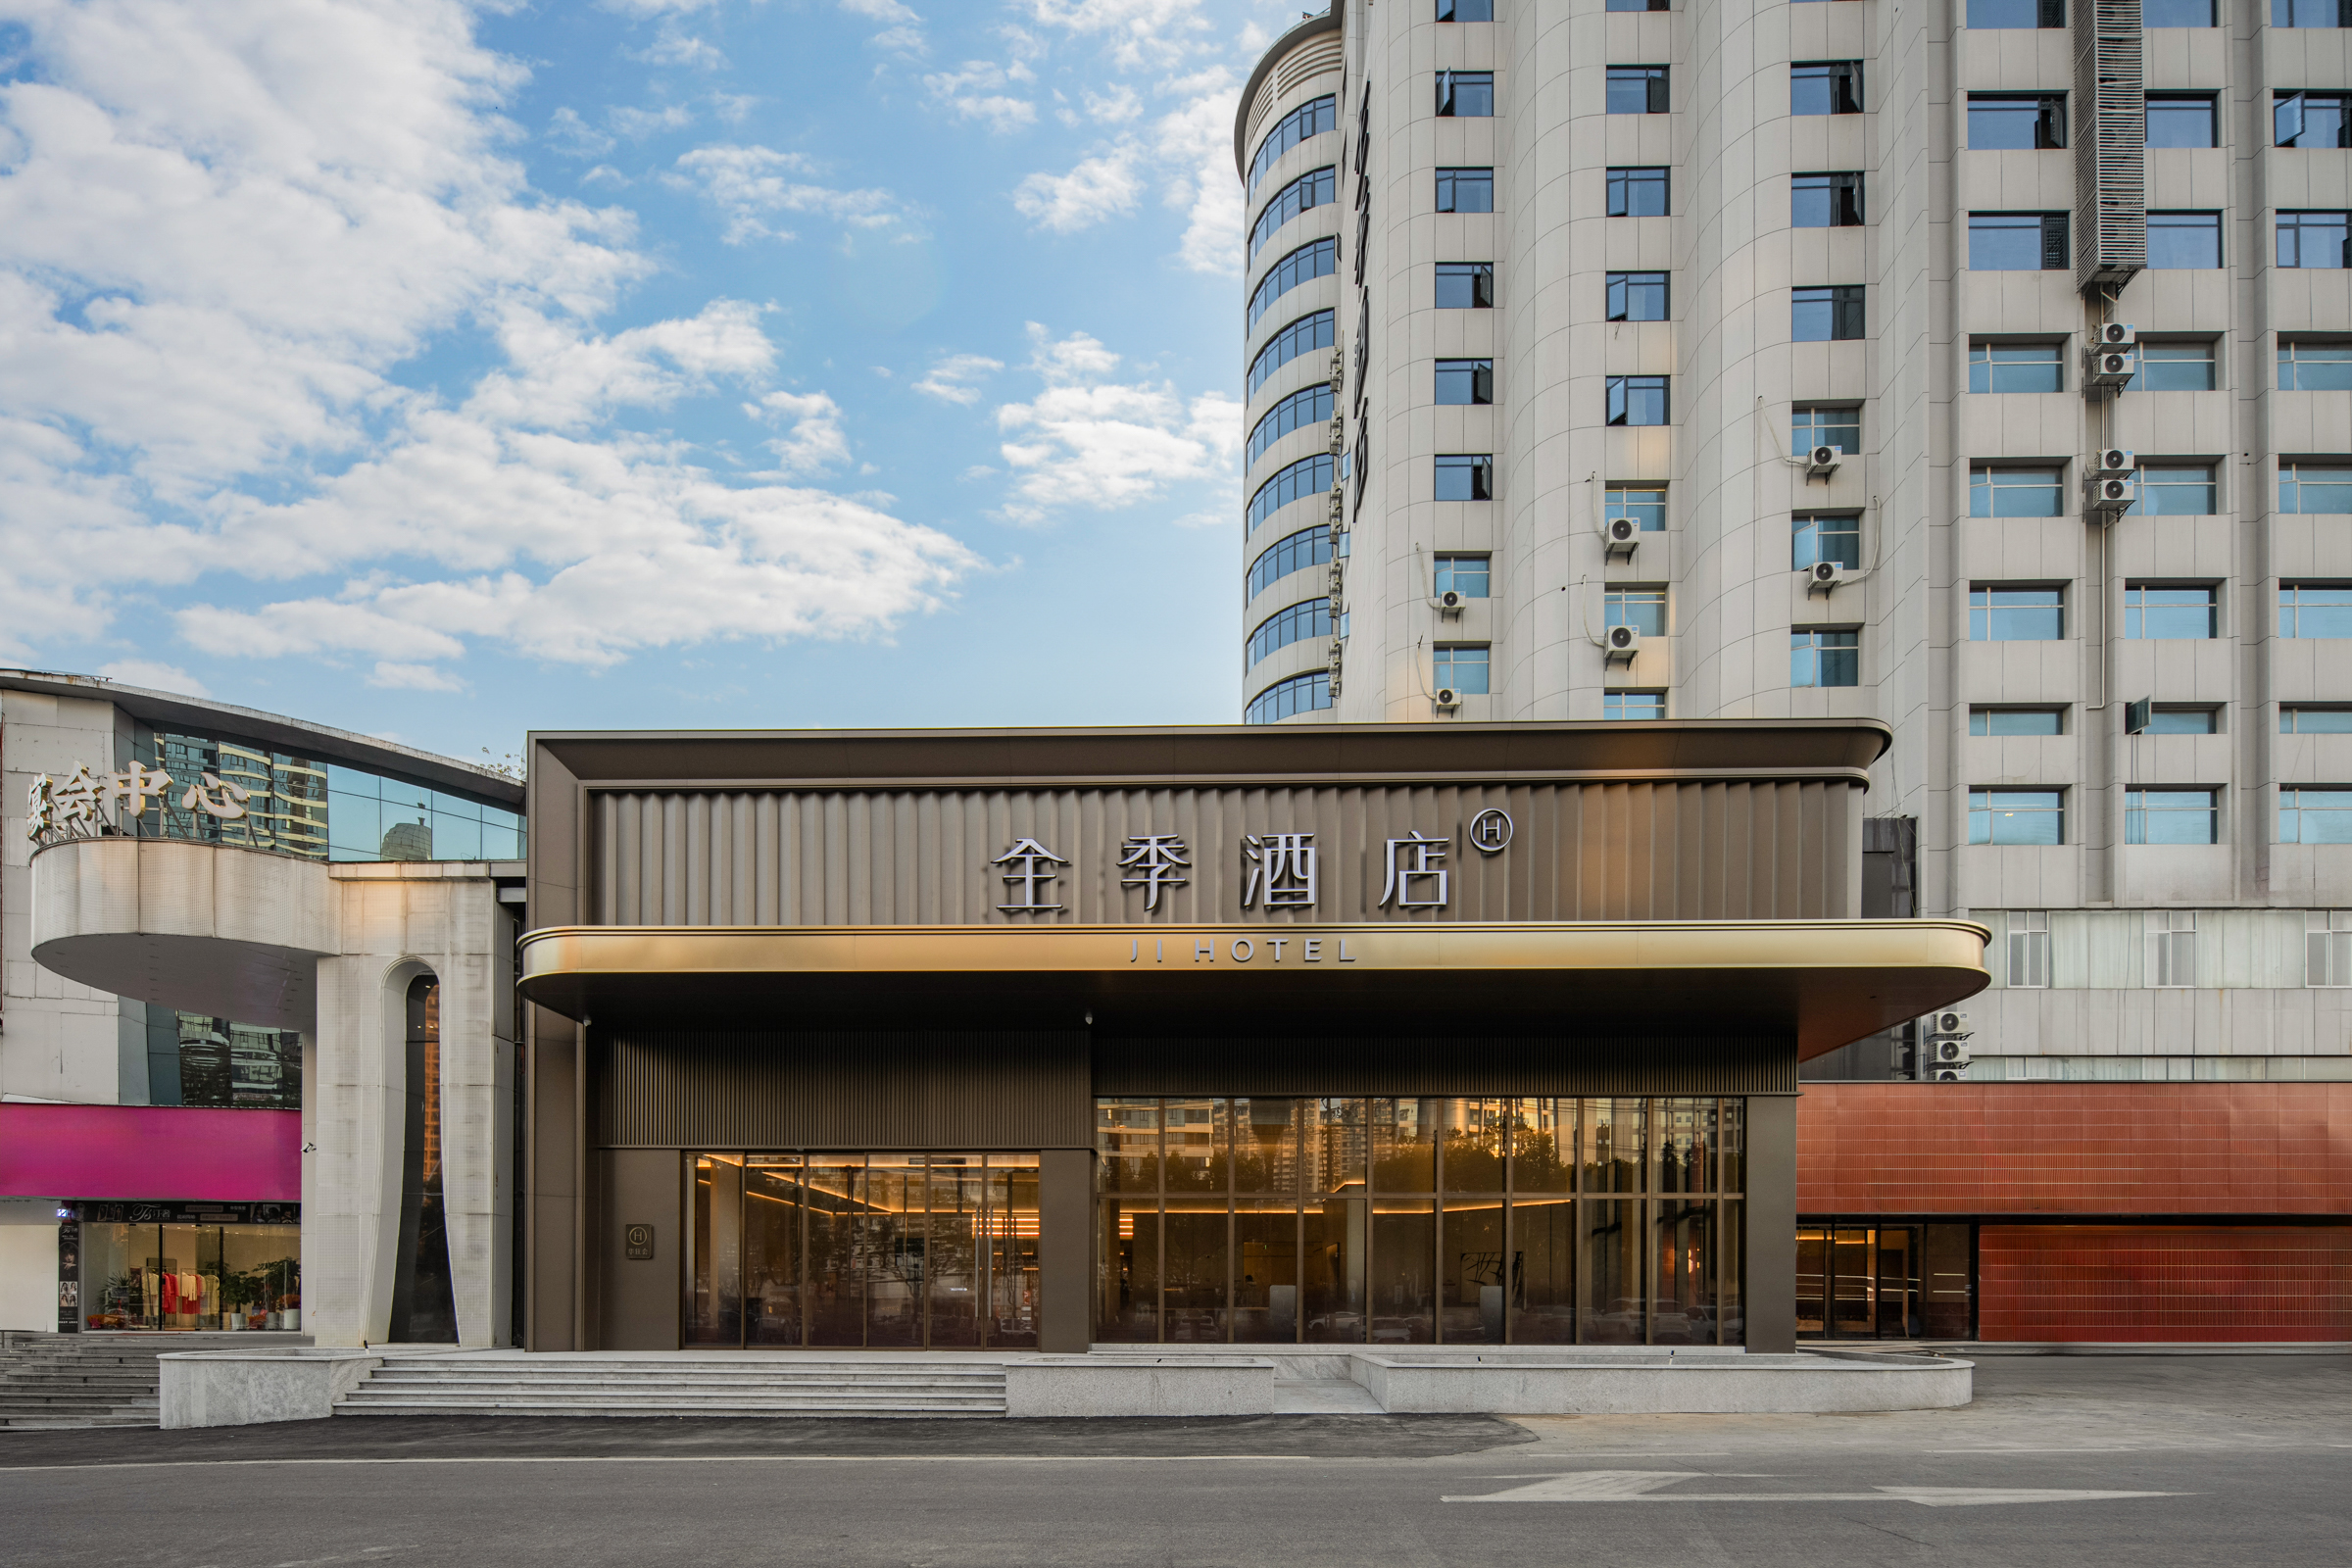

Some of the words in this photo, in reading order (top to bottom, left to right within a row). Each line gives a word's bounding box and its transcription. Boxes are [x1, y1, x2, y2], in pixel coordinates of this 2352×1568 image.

[26, 760, 251, 841] 宴会中心
[991, 830, 1449, 910] 全季酒店
[1130, 939, 1162, 962] JI
[1194, 938, 1356, 962] HOTEL
